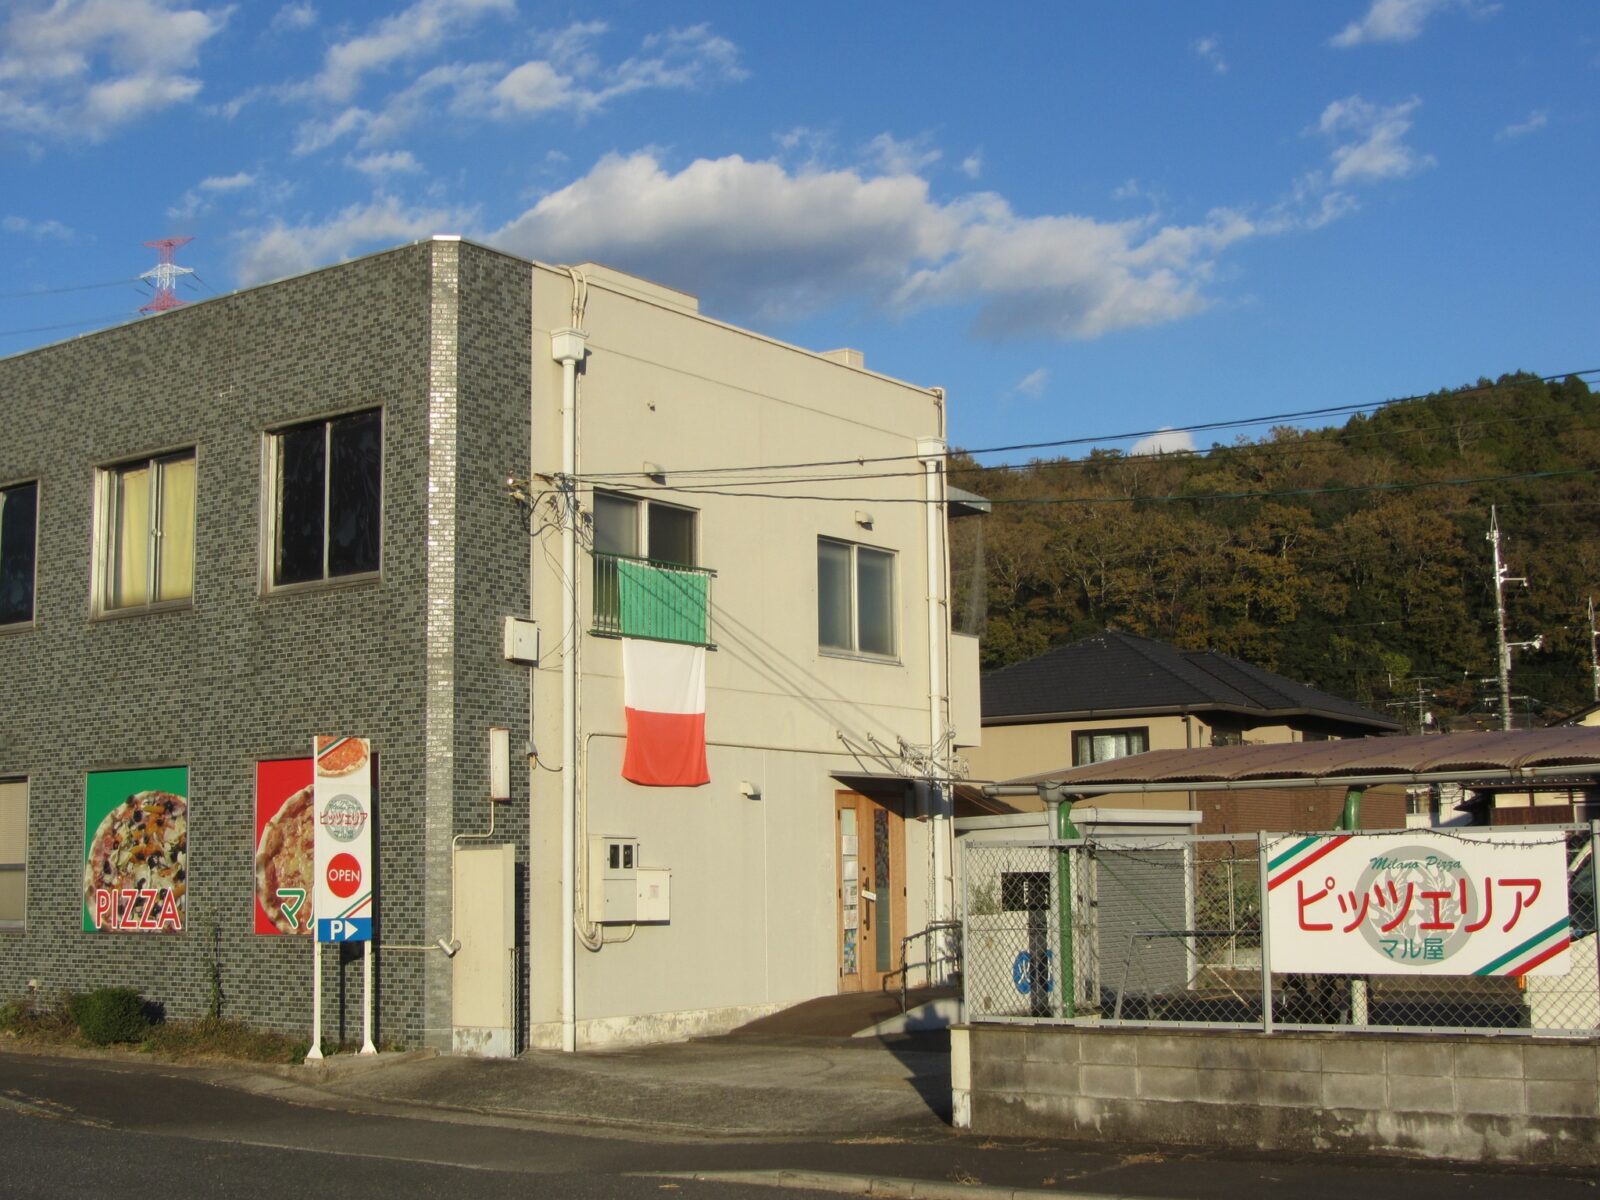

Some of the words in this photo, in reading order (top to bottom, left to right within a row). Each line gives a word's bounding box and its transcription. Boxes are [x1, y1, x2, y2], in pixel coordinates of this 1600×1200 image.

[1370, 857, 1419, 870] Milano
[1425, 856, 1461, 872] Pizza
[328, 868, 360, 882] OPEN
[96, 887, 182, 930] PIZZA
[1297, 876, 1542, 933] ピッツェリア
[331, 920, 343, 941] P
[1379, 938, 1444, 960] マル屋
